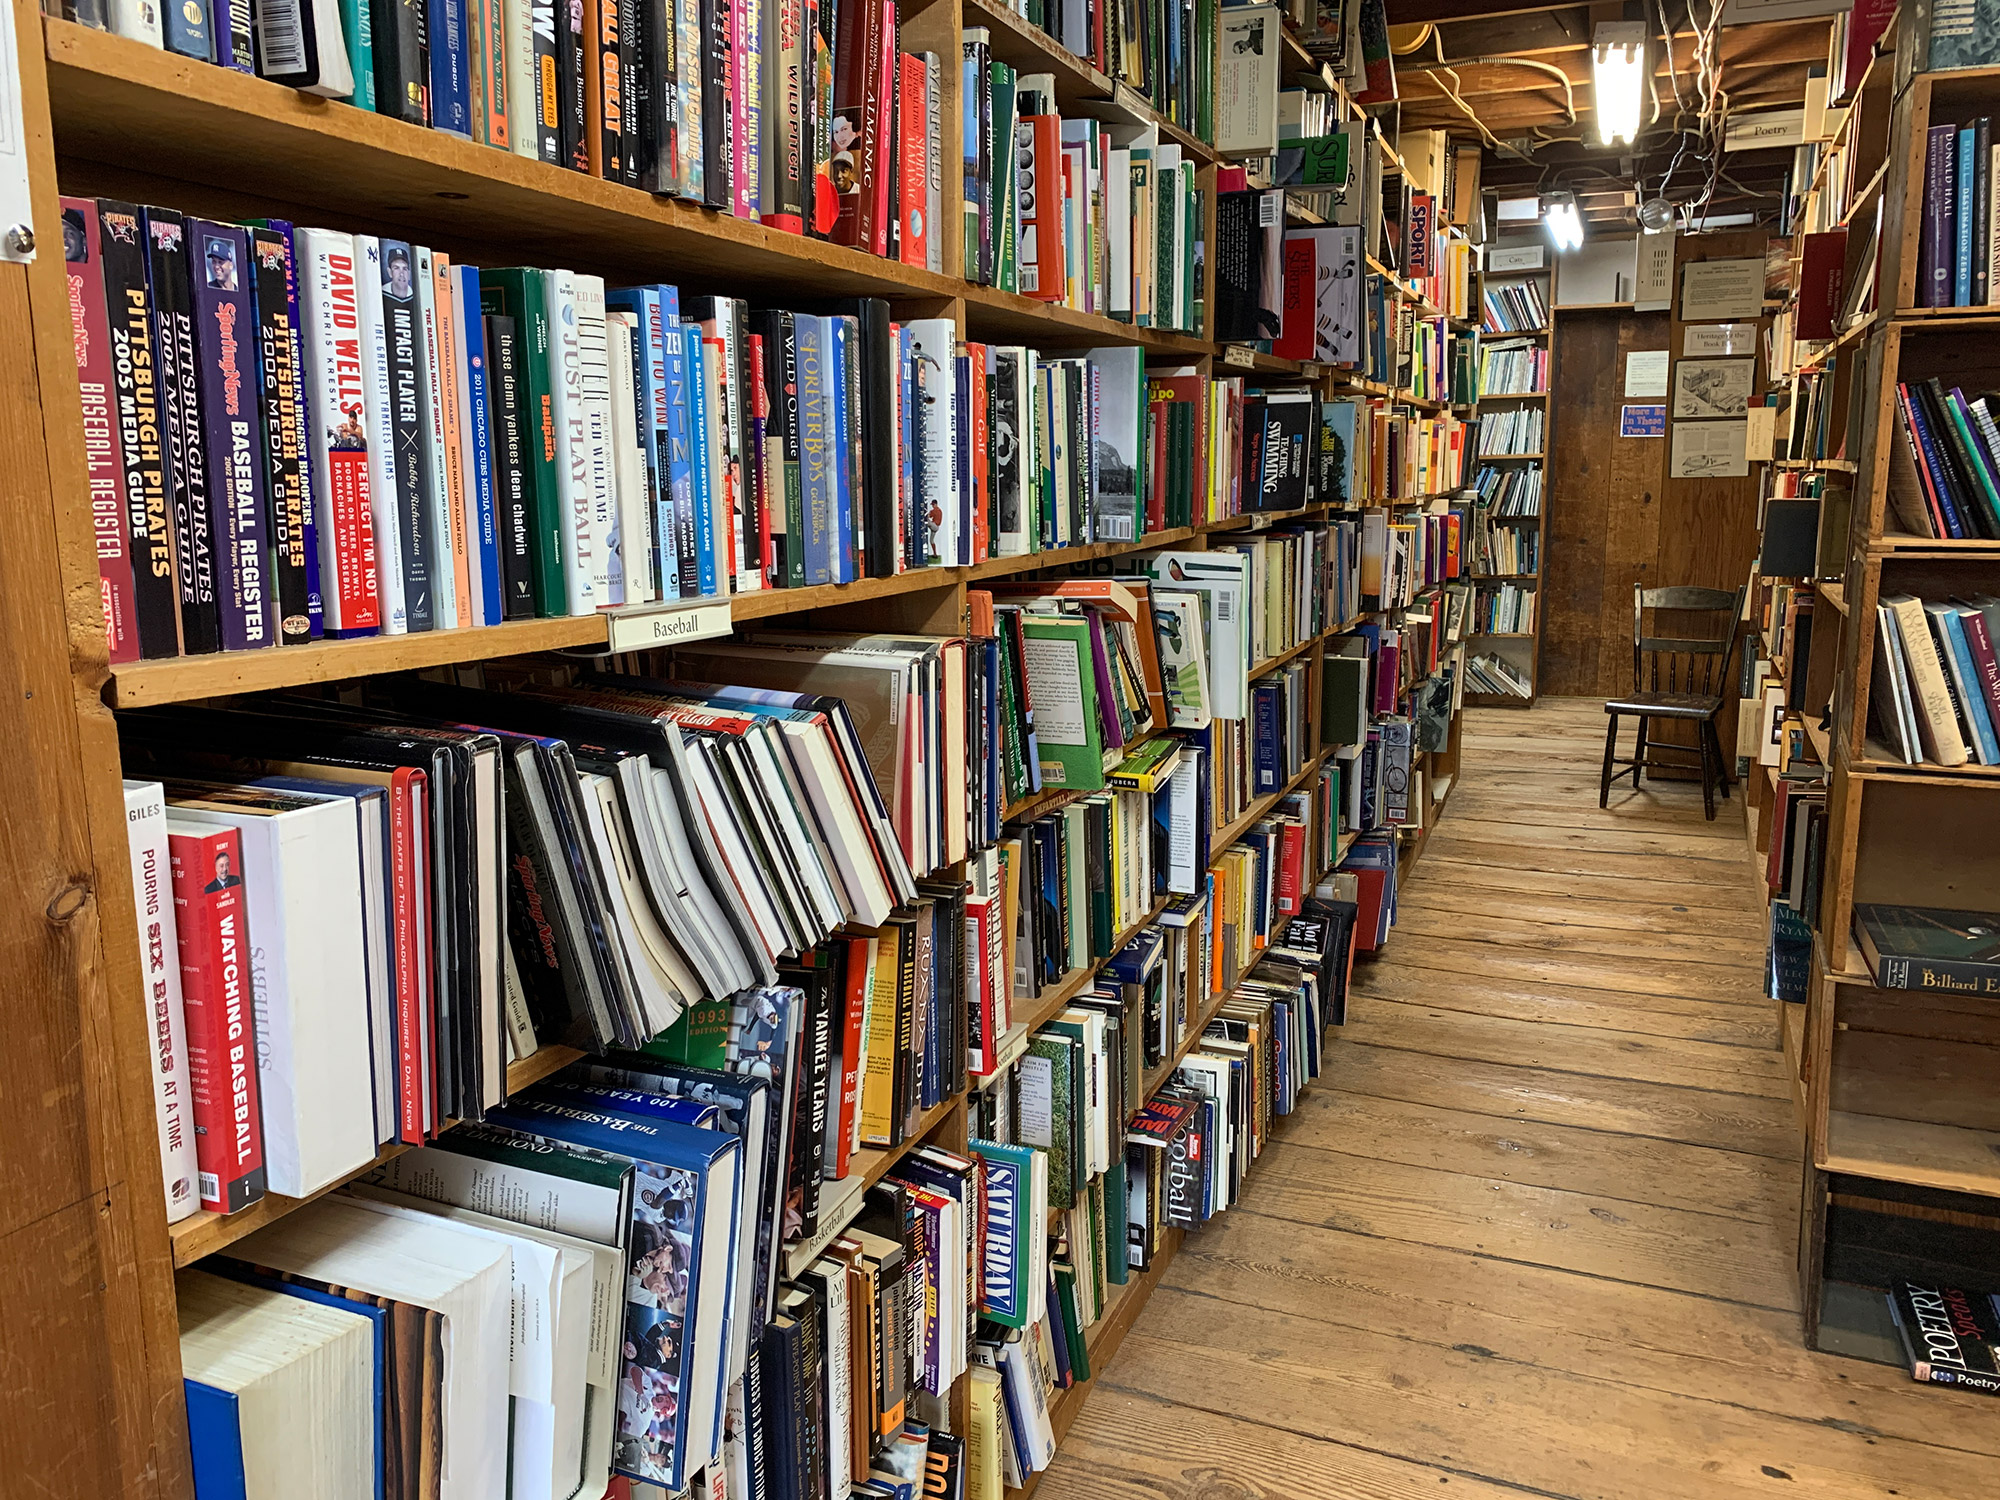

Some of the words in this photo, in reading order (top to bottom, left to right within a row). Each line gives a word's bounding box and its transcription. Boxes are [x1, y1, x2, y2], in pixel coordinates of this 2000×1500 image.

[450, 53, 458, 92] DUGOUT
[575, 47, 583, 74] Buzz
[748, 51, 761, 110] Baseball
[575, 76, 585, 125] Bissinger
[603, 51, 621, 137] GREAT
[787, 64, 798, 118] WILD
[788, 120, 799, 182] PITCH
[863, 91, 876, 189] ALMANAC
[1754, 126, 1788, 136] Poetry
[1944, 133, 1954, 184] DONALD
[1944, 188, 1953, 219] HALL
[1961, 188, 1970, 252] DESTINATION
[1410, 205, 1427, 268] SPORT
[319, 253, 328, 290] WITH
[328, 254, 357, 330] DAVID
[1959, 255, 1968, 280] ZERO
[159, 312, 175, 376] 2004
[322, 302, 333, 346] CHRIS
[374, 323, 384, 340] THE
[394, 309, 413, 366] IMPACT
[649, 303, 663, 349] BUILT
[113, 327, 134, 389] 2005
[262, 325, 277, 388] 2006
[289, 328, 302, 401] BASEBALL'S
[335, 339, 363, 416] WELLS
[376, 346, 389, 395] GREATEST
[501, 334, 513, 370] those
[562, 332, 582, 406] JUST
[653, 360, 666, 381] TO
[785, 335, 796, 382] WILD
[273, 312, 298, 460] PITTSBURGH
[327, 357, 338, 411] KRESKI
[398, 370, 416, 422] PLAYER
[474, 374, 482, 396] 2011
[503, 375, 515, 409] damn
[634, 364, 644, 441] TEAMMATES
[654, 388, 668, 426] WIN
[800, 338, 823, 438] FOREVER
[1158, 390, 1175, 399] DO
[79, 382, 112, 471] BASEBALL
[120, 395, 140, 467] MEDIA
[126, 289, 160, 461] PITTSBURGH
[143, 470, 170, 578] PIRATES
[166, 387, 184, 493] MEDIA
[267, 399, 283, 474] MEDIA
[295, 402, 307, 458] BIGGEST
[380, 402, 392, 445] YANKEES
[475, 398, 485, 447] CHICAGO
[505, 414, 519, 465] yankees
[541, 394, 555, 462] Ballpark
[590, 411, 602, 440] TED
[787, 396, 798, 457] Outside
[978, 419, 986, 455] Golf
[1250, 432, 1260, 449] Steps
[1624, 416, 1633, 425] In
[1636, 416, 1662, 425] These
[177, 314, 204, 489] PITTSBURGH
[192, 494, 213, 603] PIRATES
[231, 421, 255, 533] BASEBALL
[383, 449, 394, 481] TEAMS
[408, 452, 418, 489] Bobby
[480, 448, 488, 476] CUBS
[569, 417, 587, 487] PLAY
[803, 438, 824, 482] BOYS
[1250, 458, 1258, 482] Success
[1263, 421, 1281, 493] SWIMMING
[1278, 436, 1289, 478] TEACHING
[128, 471, 148, 538] GUIDE
[299, 460, 312, 526] BLOOPERS
[344, 462, 353, 503] BOOMER
[357, 461, 373, 535] PERFECT
[481, 478, 490, 511] MEDIA
[511, 469, 523, 499] dean
[592, 446, 607, 523] WILLIAMS
[90, 479, 122, 559] REGISTER
[273, 483, 289, 556] GUIDE
[285, 473, 305, 567] PIRATES
[335, 462, 345, 523] BACKACHES,
[341, 548, 351, 601] BASEBALL
[347, 507, 354, 520] ON
[349, 524, 357, 553] BEER,
[410, 492, 423, 556] Richardson
[483, 513, 492, 545] GUIDE
[512, 503, 526, 555] chadwin
[574, 497, 592, 569] BALL
[687, 508, 695, 558] ZIMMER
[810, 488, 820, 545] GOLENBOCK
[177, 502, 194, 603] GUIDE
[362, 536, 374, 562] I'M
[240, 540, 263, 641] REGISTER
[352, 557, 361, 600] BRAWLS,
[365, 568, 377, 599] NOT
[653, 614, 699, 638] Baseball
[1986, 659, 1996, 679] The
[129, 803, 160, 822] GILES
[142, 848, 159, 916] POURING
[147, 922, 164, 974] SIX
[1776, 922, 1812, 938] RYAN
[219, 913, 243, 1040] WATCHING
[819, 987, 828, 1008] The
[1921, 972, 1979, 991] Billiard
[152, 978, 174, 1074] BEERS
[690, 1009, 726, 1025] 1993
[814, 1009, 829, 1074] YANKEE
[163, 1081, 177, 1097] AT
[166, 1102, 178, 1113] A
[230, 1044, 251, 1166] BASEBALL
[597, 1090, 644, 1102] YEARS
[649, 1098, 679, 1109] 100
[812, 1077, 826, 1133] YEARS
[167, 1114, 182, 1152] TIME
[809, 1206, 845, 1253] Basketball
[985, 1167, 1014, 1309] SATURDAY
[1905, 1281, 1967, 1371] POETRY
[1957, 1373, 2000, 1391] Poetry
